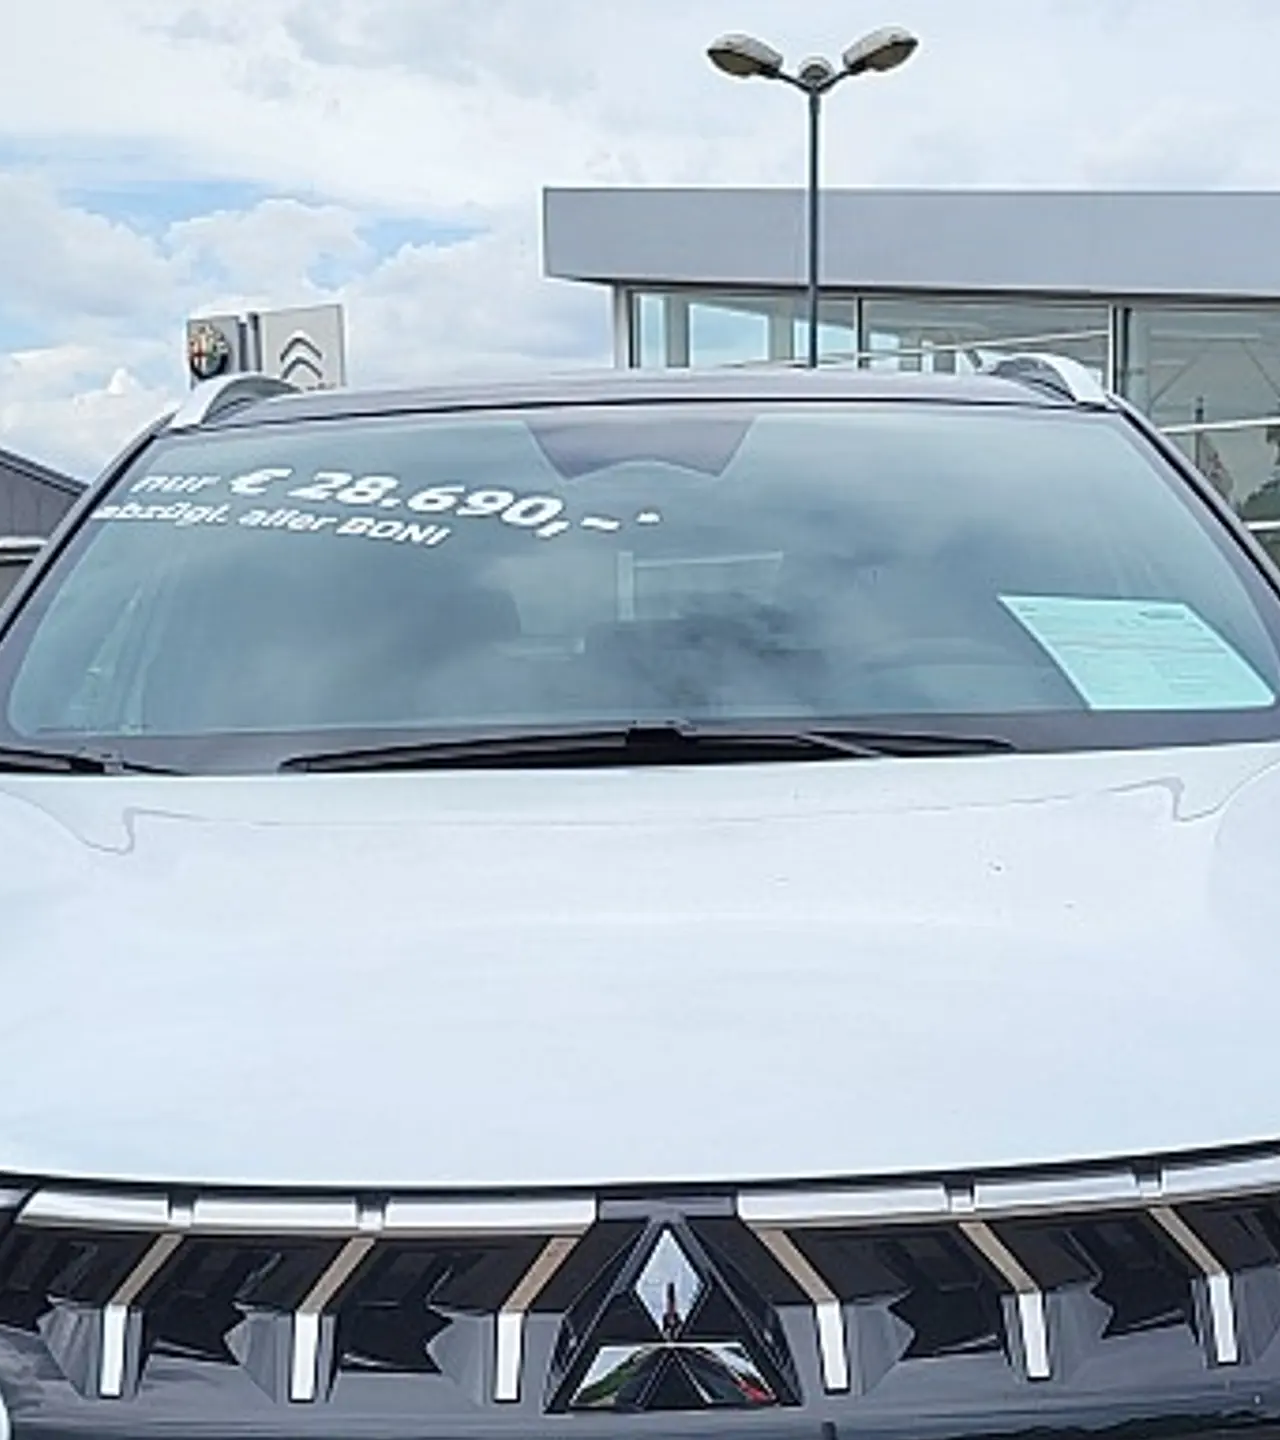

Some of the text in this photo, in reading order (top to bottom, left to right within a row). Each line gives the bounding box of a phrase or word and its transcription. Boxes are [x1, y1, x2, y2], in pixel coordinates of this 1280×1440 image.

[130, 474, 221, 494] nur
[228, 467, 294, 496] €
[238, 508, 338, 532] aller
[335, 515, 452, 545] BONI
